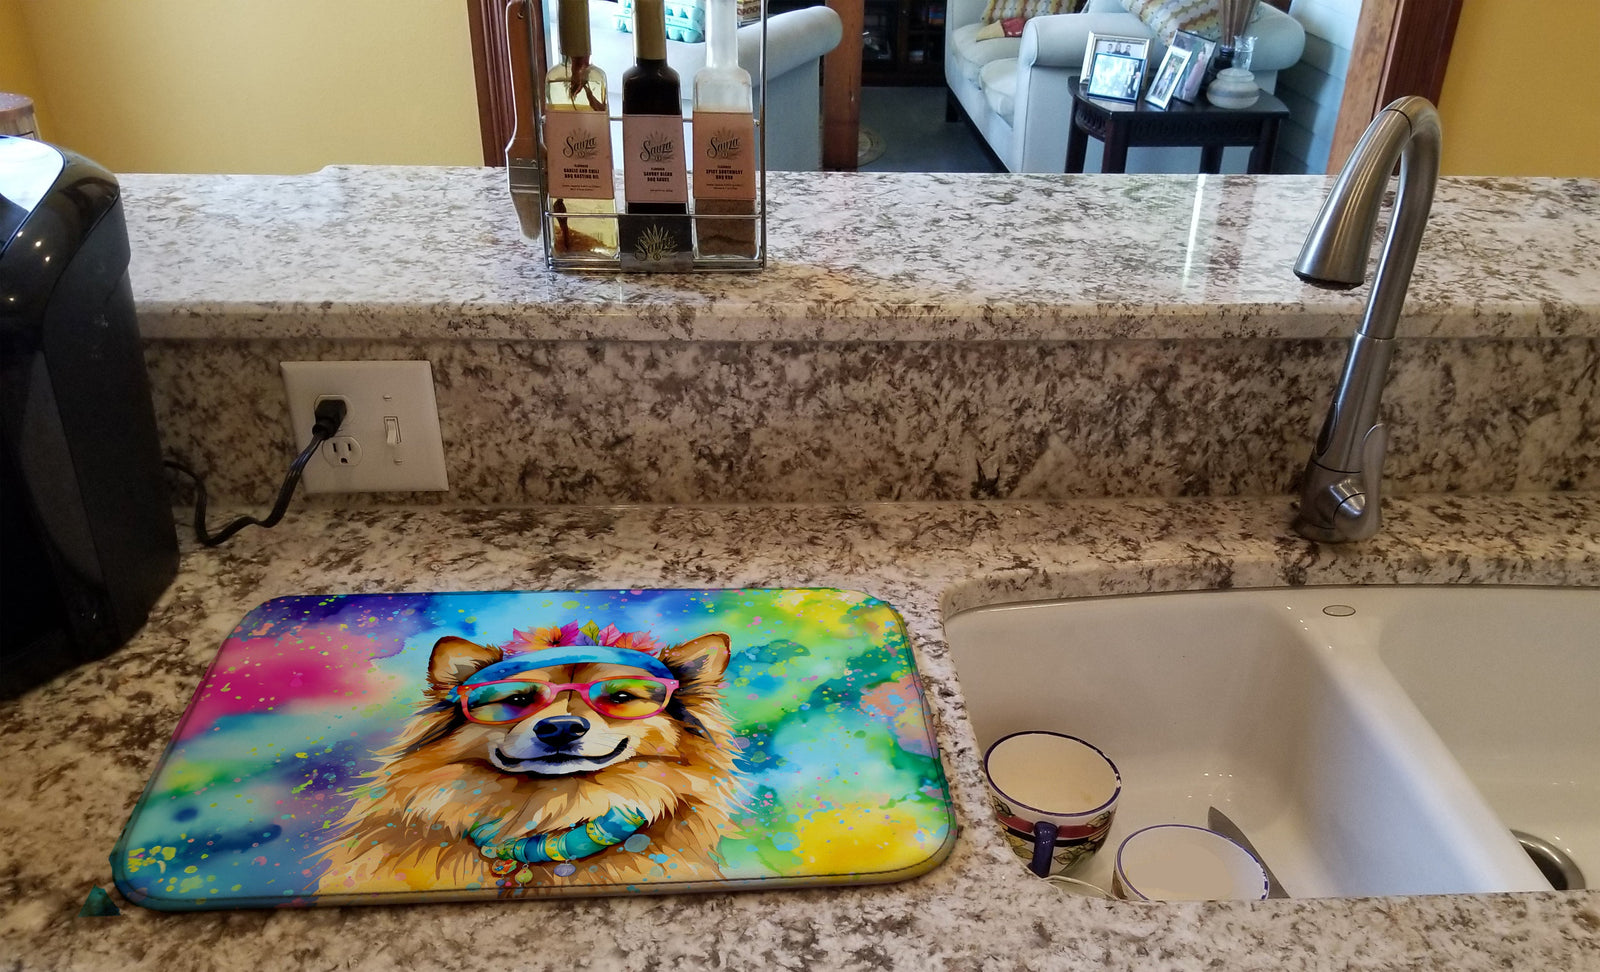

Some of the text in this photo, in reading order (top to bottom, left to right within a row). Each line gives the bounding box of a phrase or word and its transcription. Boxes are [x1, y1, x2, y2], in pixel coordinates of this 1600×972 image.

[563, 136, 597, 158] Sauza
[640, 140, 673, 161] Sauza
[707, 136, 740, 158] Sauza
